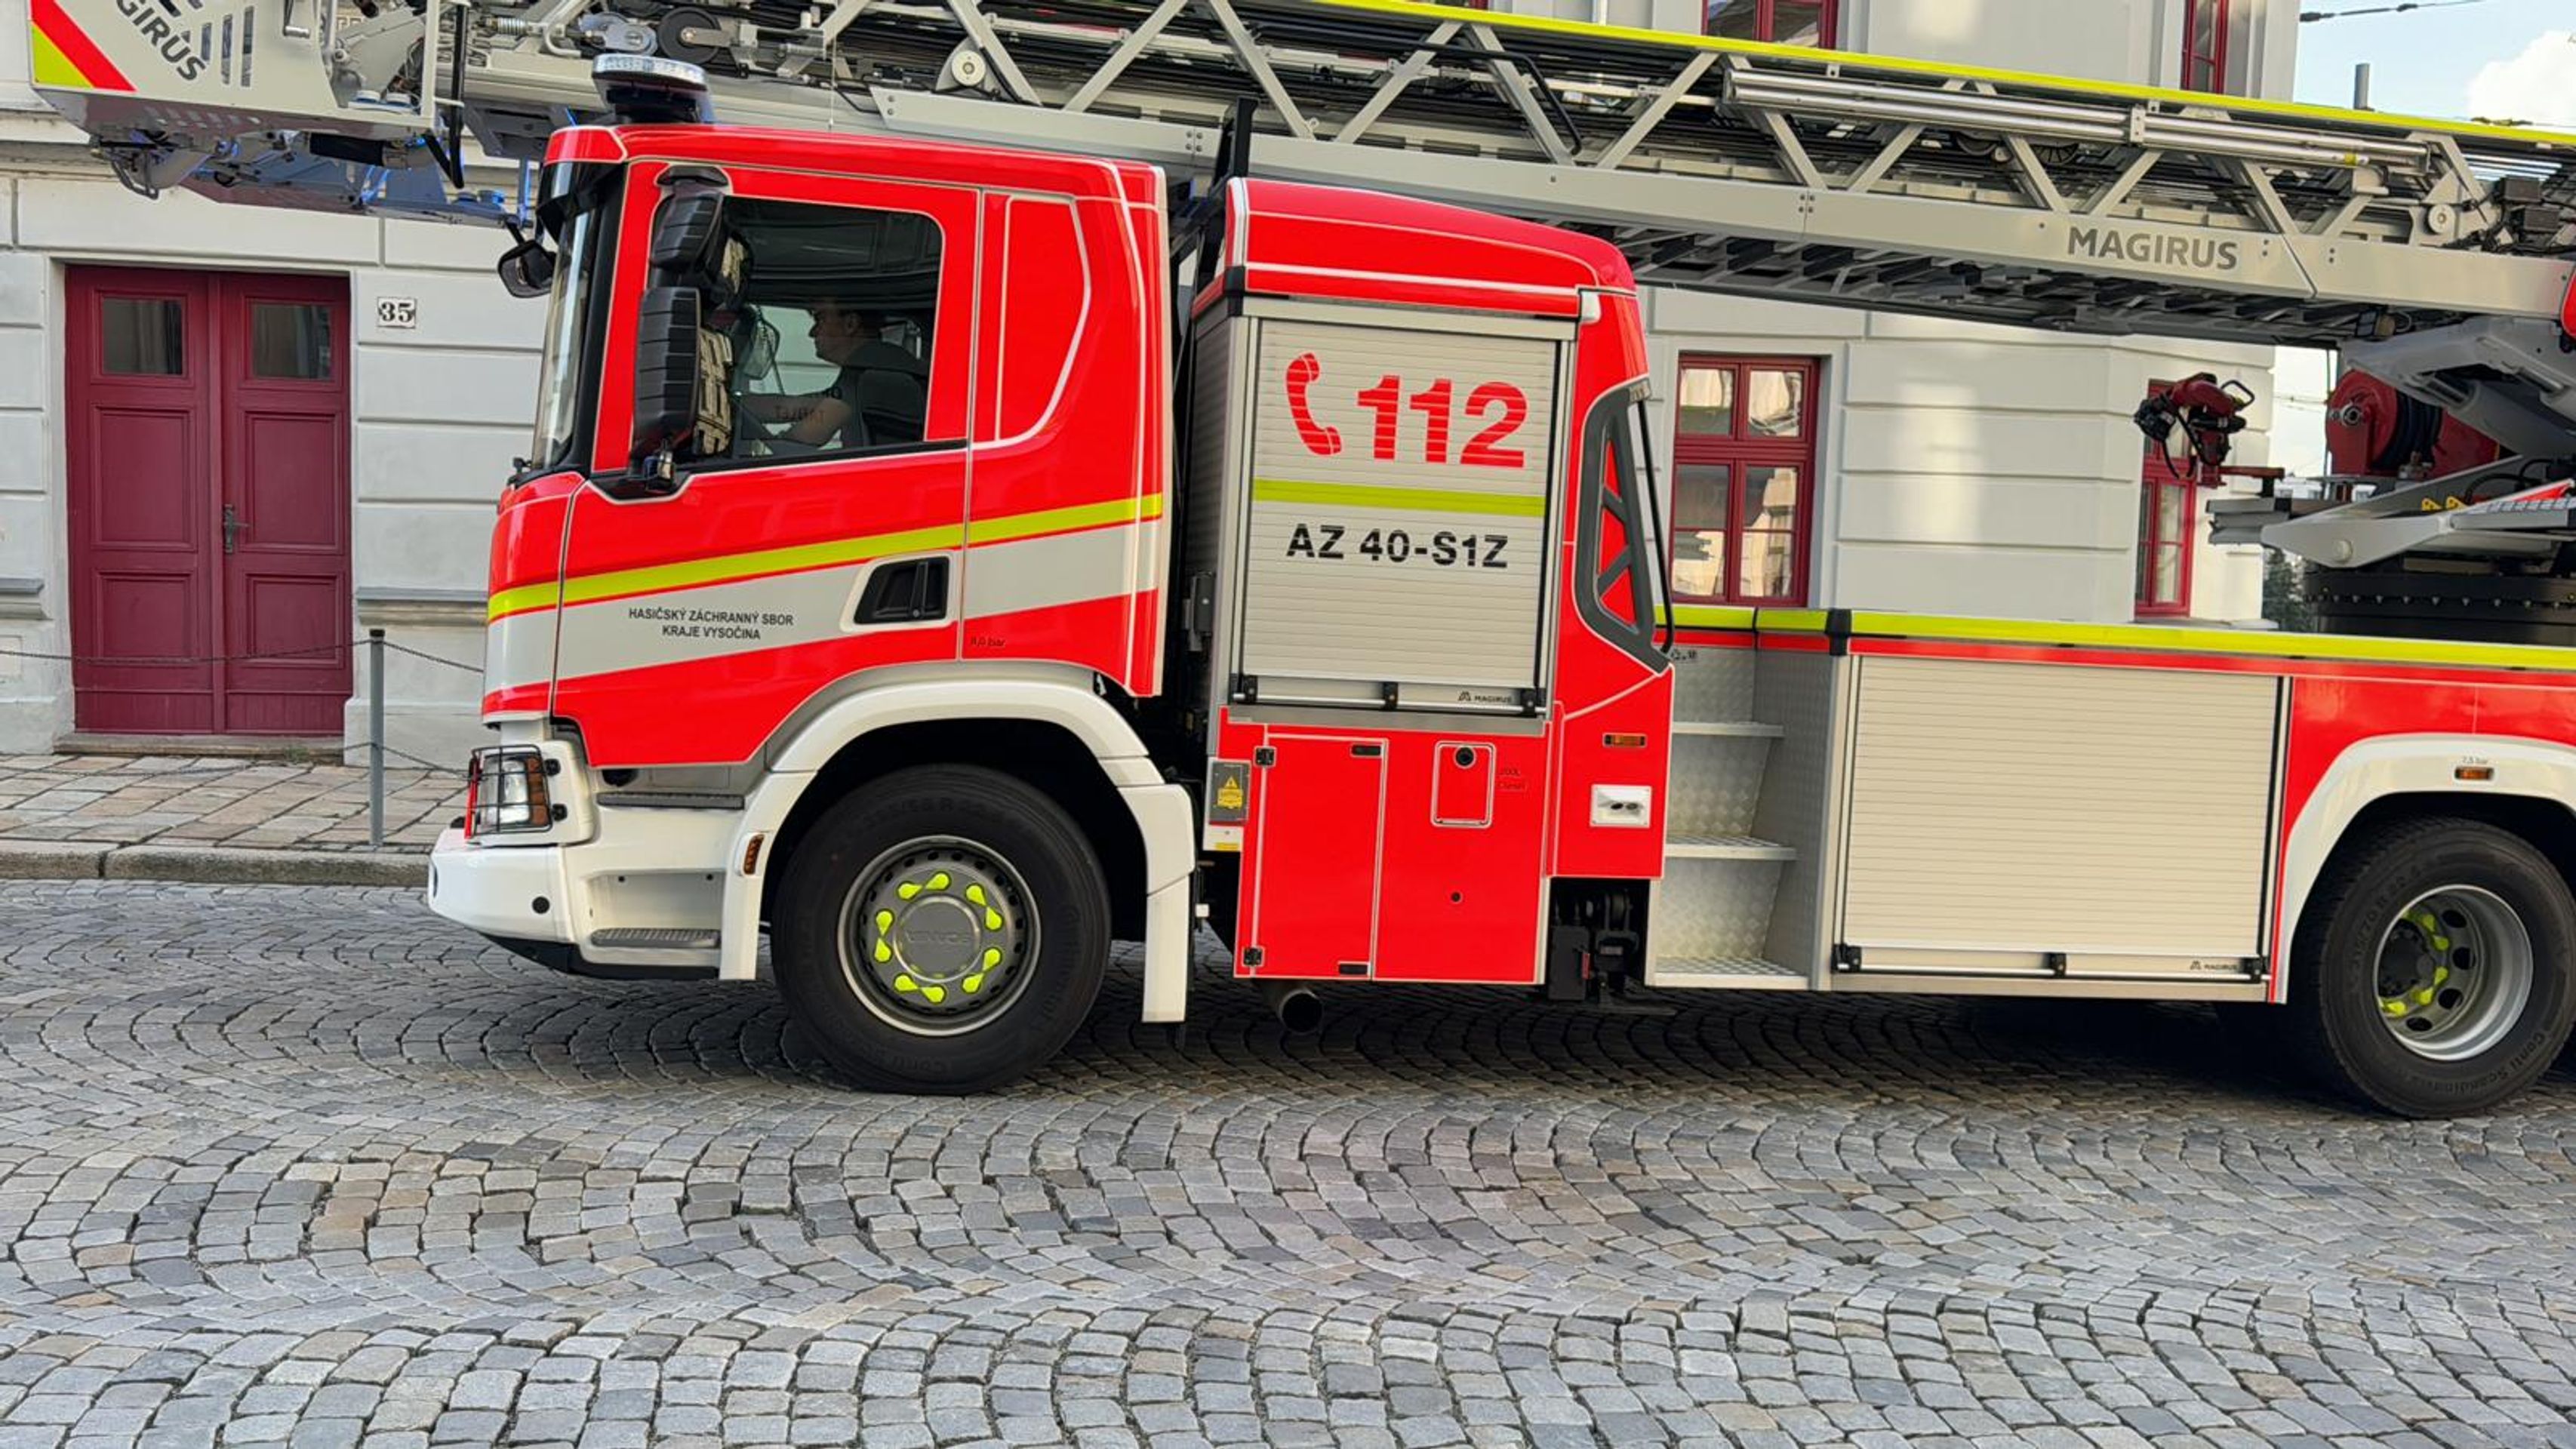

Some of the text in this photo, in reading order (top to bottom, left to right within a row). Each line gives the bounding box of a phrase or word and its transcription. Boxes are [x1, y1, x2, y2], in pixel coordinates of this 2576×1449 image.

[2068, 226, 2238, 270] MAGIRUS
[381, 302, 413, 322] 35
[1357, 374, 1528, 469] 112
[1286, 523, 1509, 568] AZ 40-S1Z
[629, 607, 794, 626] HASIČSKÝ ZÁCHRANNÝ SBOR
[662, 625, 761, 640] KRAJE VYSOČINA
